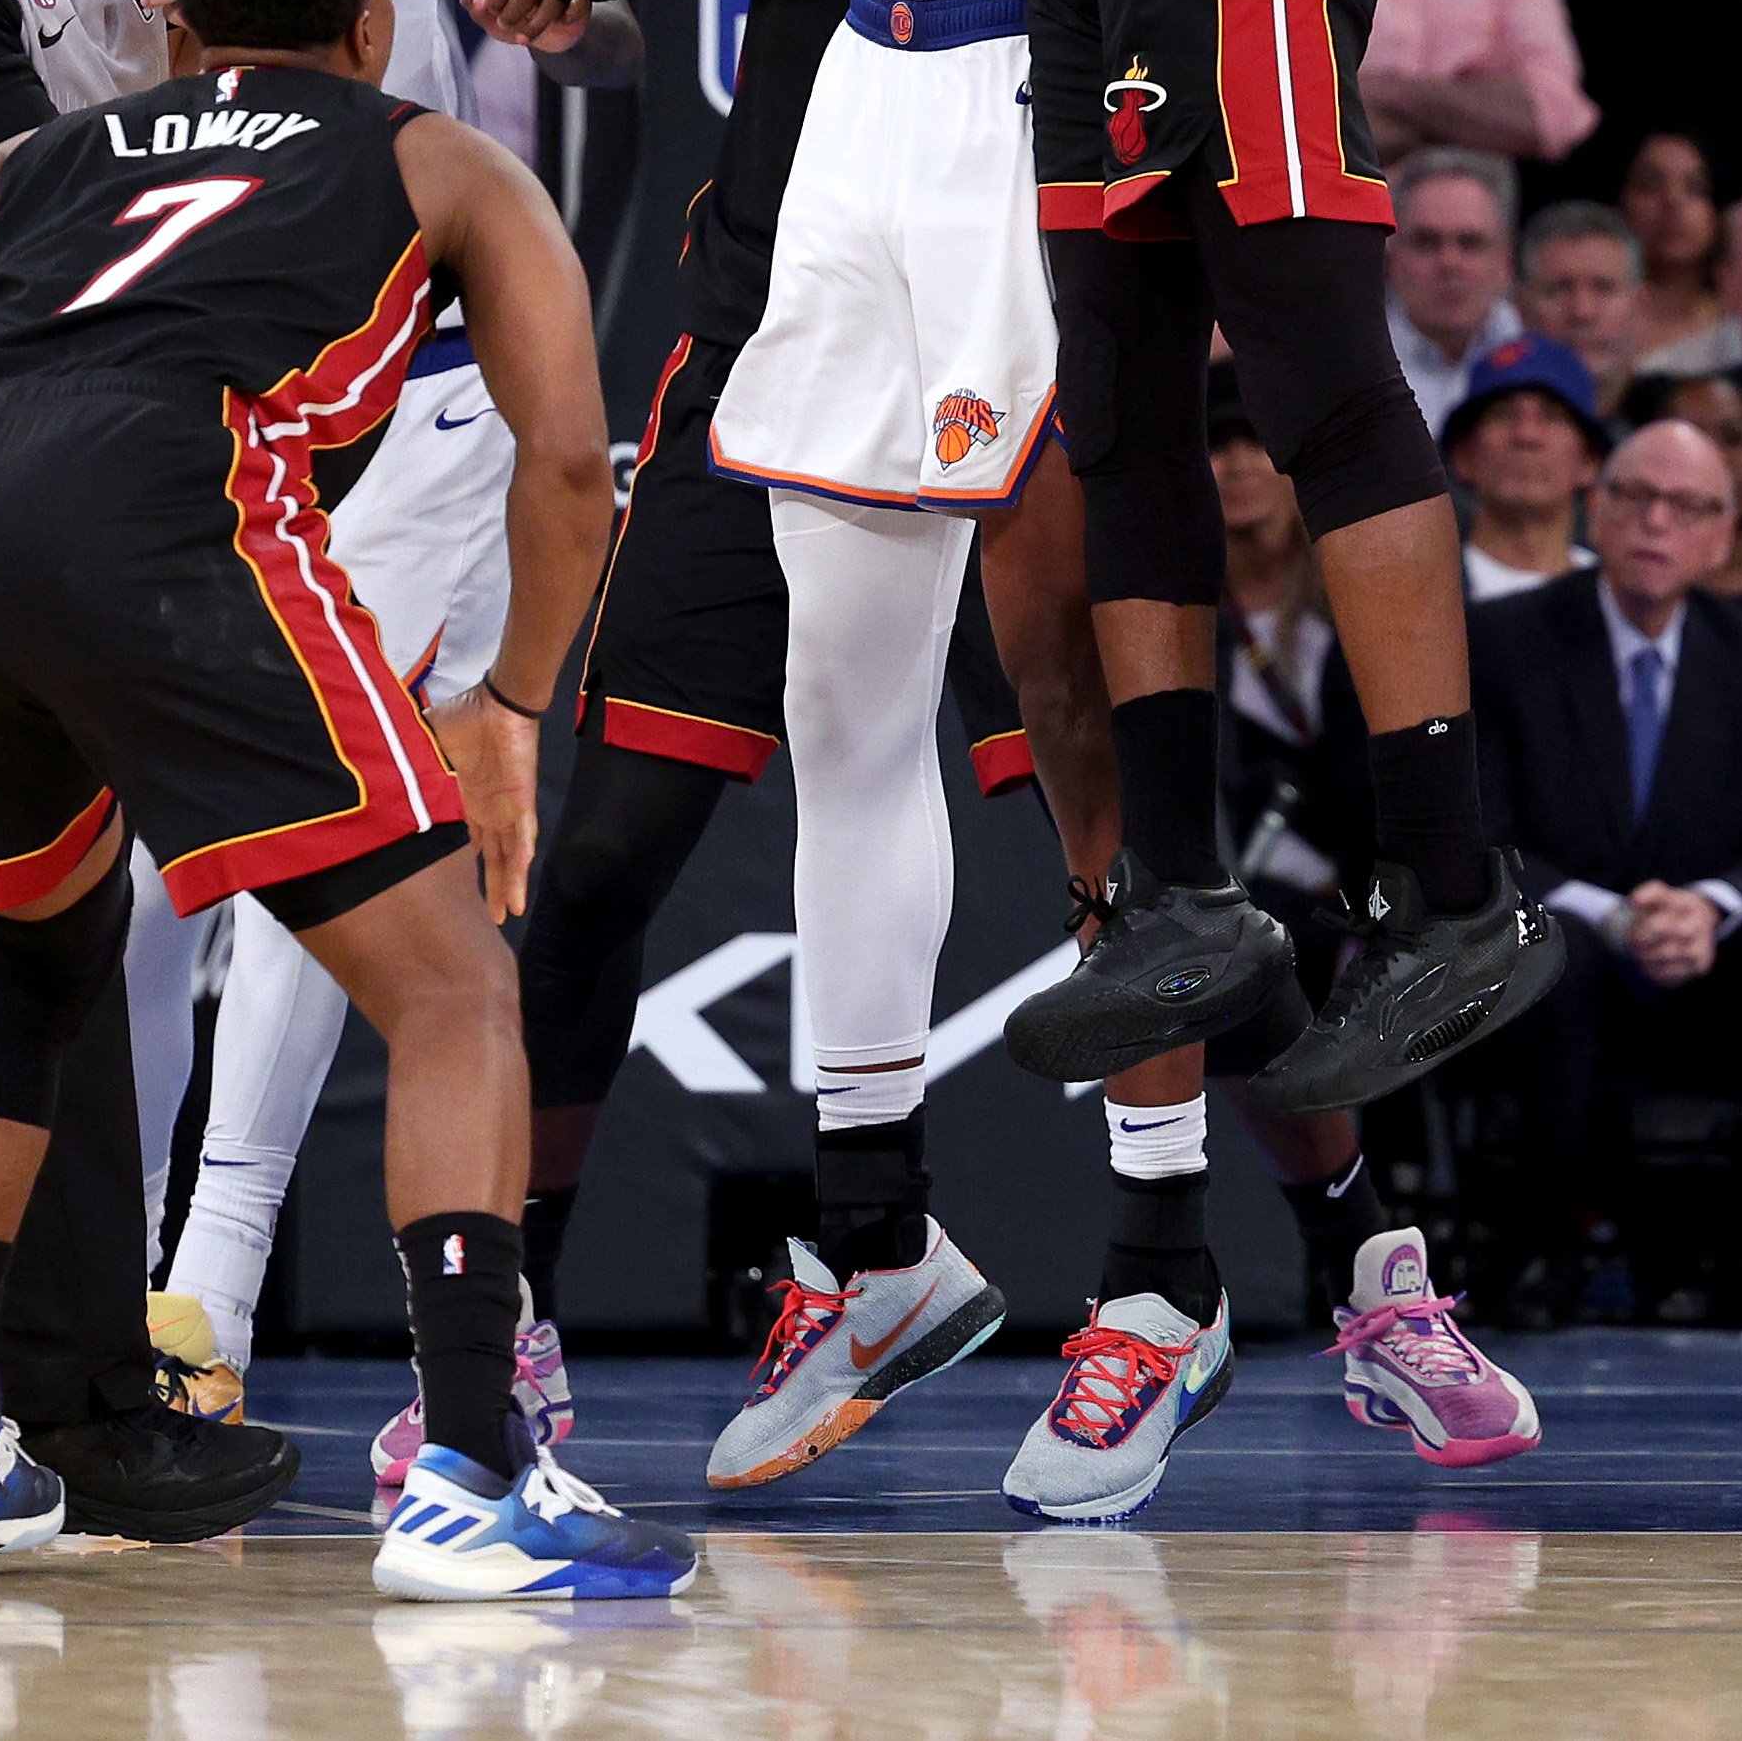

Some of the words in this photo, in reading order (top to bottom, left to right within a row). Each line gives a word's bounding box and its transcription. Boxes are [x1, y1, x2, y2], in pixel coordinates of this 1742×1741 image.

[103, 108, 322, 158] LOWRY
[49, 174, 267, 317] 7
[1428, 719, 1449, 736] alo
